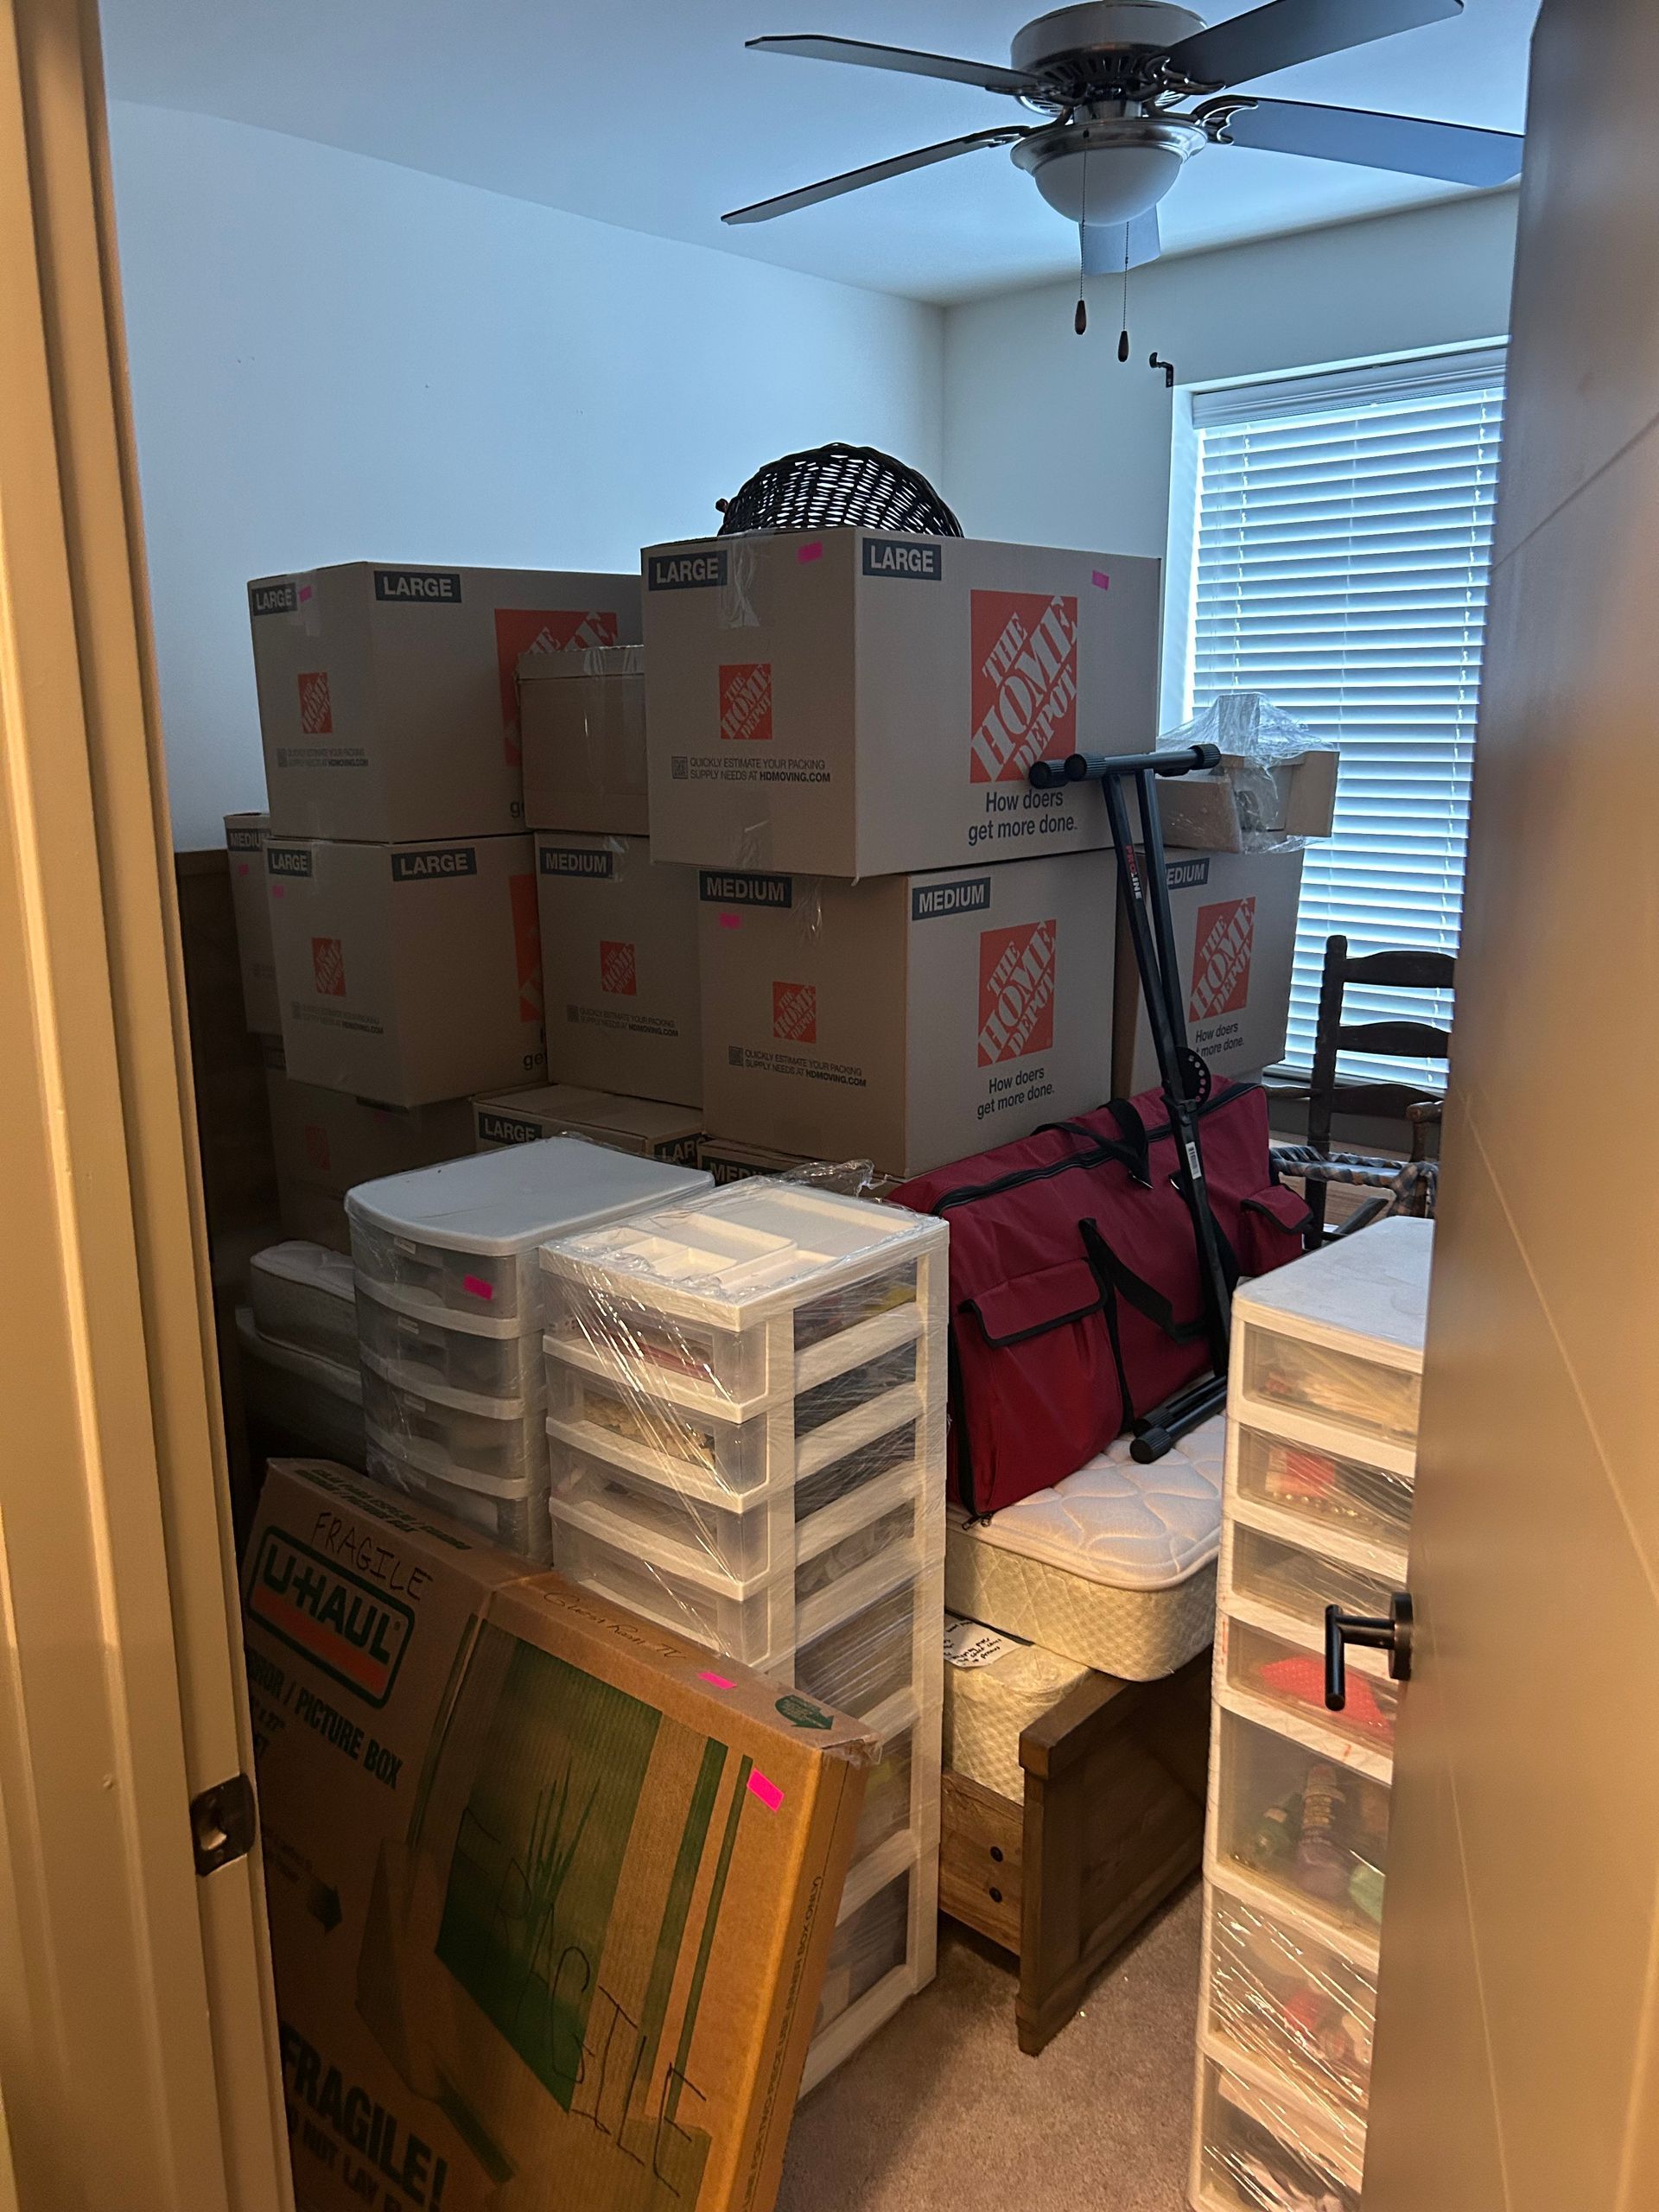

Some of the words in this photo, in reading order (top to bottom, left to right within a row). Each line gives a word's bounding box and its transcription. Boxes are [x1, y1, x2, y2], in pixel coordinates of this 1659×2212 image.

[656, 559, 719, 585] LARGE
[871, 545, 934, 573] LARGE
[256, 588, 293, 611] LARGE
[384, 577, 454, 598] LARGE
[982, 611, 1028, 689] THE
[720, 664, 772, 740] HOME
[970, 594, 1077, 783] HOME
[1013, 664, 1077, 777] DEPOT
[690, 758, 721, 768] QUICKLY
[723, 758, 761, 769] ESTIMATE
[762, 759, 786, 769] YOUR
[788, 760, 826, 770] PACKING
[690, 769, 719, 779] SUPPLY
[721, 770, 748, 780] NEEDS
[748, 771, 758, 781] AT
[759, 771, 831, 783] HDMOVING.COM
[985, 792, 1018, 813] How
[1022, 790, 1064, 810] doers
[968, 822, 994, 847] get
[997, 820, 1035, 838] more
[270, 853, 308, 872] LARGE
[400, 854, 469, 876] LARGE
[545, 852, 607, 874] MEDIUM
[1167, 863, 1205, 886] EDIUM
[707, 876, 785, 901] MEDIUM
[918, 884, 985, 914] MEDIUM
[987, 941, 1020, 997] THE
[1191, 897, 1254, 1020] HOME
[978, 918, 1056, 1064] HOME
[1008, 969, 1054, 1057] DEPOT
[1196, 1029, 1214, 1044] How
[1216, 1022, 1238, 1037] doers
[745, 1050, 773, 1061] QUICKLY
[774, 1054, 808, 1068] ESTIMATE
[808, 1059, 830, 1071] YOUR
[830, 1063, 862, 1077] PACKING
[1201, 1044, 1222, 1058] more
[796, 1067, 806, 1077] AT
[988, 1075, 1012, 1094] How
[1014, 1068, 1045, 1087] doers
[977, 1100, 995, 1121] get
[997, 1092, 1025, 1111] more
[484, 1117, 536, 1143] LARGE
[312, 1511, 434, 1601] FRAGILE
[262, 1542, 391, 1666] U-HAUL
[543, 1592, 607, 1624] Guest
[656, 1643, 688, 1660] TV
[295, 1687, 365, 1761] PICTURE
[363, 1738, 404, 1791] BOX
[797, 1922, 810, 1956] BOX
[454, 1806, 708, 2199] FRAGILE
[280, 2018, 448, 2205] FRAGILE!
